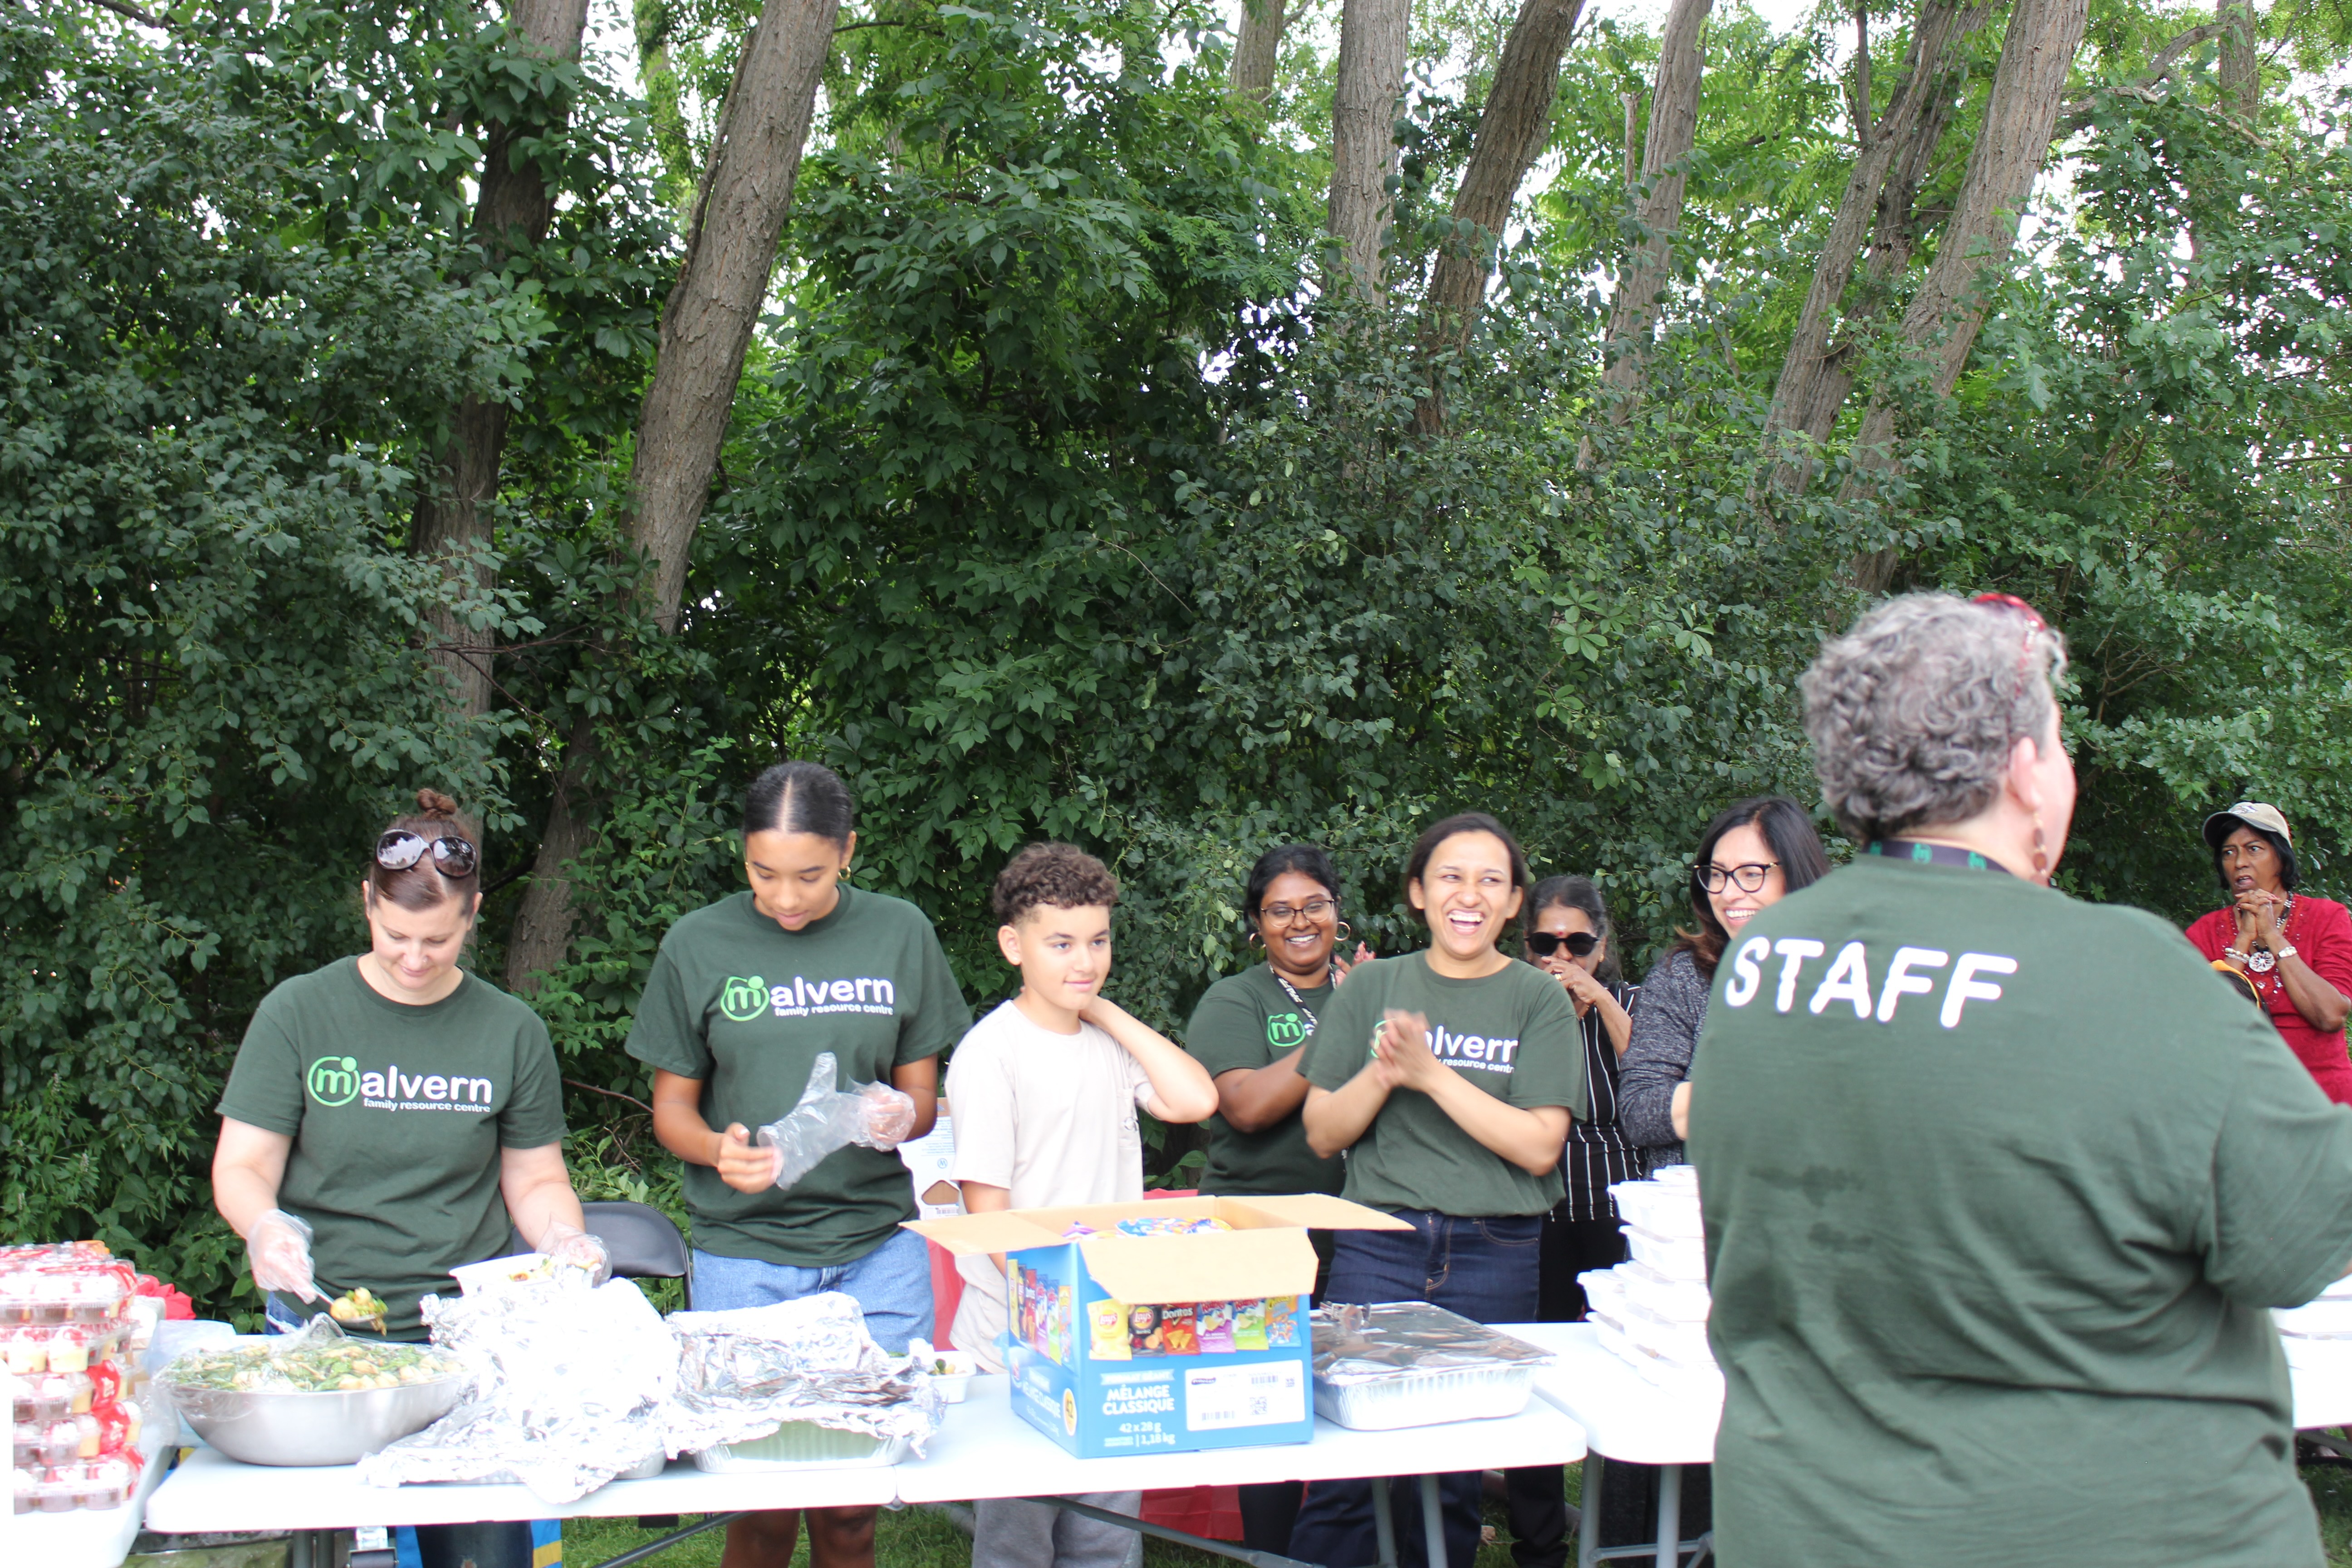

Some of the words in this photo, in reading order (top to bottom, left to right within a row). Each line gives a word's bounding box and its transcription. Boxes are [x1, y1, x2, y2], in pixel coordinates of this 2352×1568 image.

[1725, 936, 2018, 1029] STAFF
[728, 975, 894, 1012] malvern
[774, 1007, 809, 1017] family
[811, 1004, 862, 1014] resource
[1443, 1058, 1486, 1070] resource
[1488, 1063, 1514, 1074] centr
[315, 1064, 493, 1104] malvern
[363, 1097, 398, 1112] family
[400, 1101, 452, 1111] resource
[454, 1102, 491, 1113] centre
[1134, 1312, 1152, 1323] Lay's
[1162, 1308, 1193, 1319] Doritos
[1107, 1384, 1170, 1401] MÉLANGE
[1102, 1398, 1175, 1416] CLASSIQUE
[1119, 1422, 1132, 1433] 42
[1140, 1421, 1153, 1431] 28
